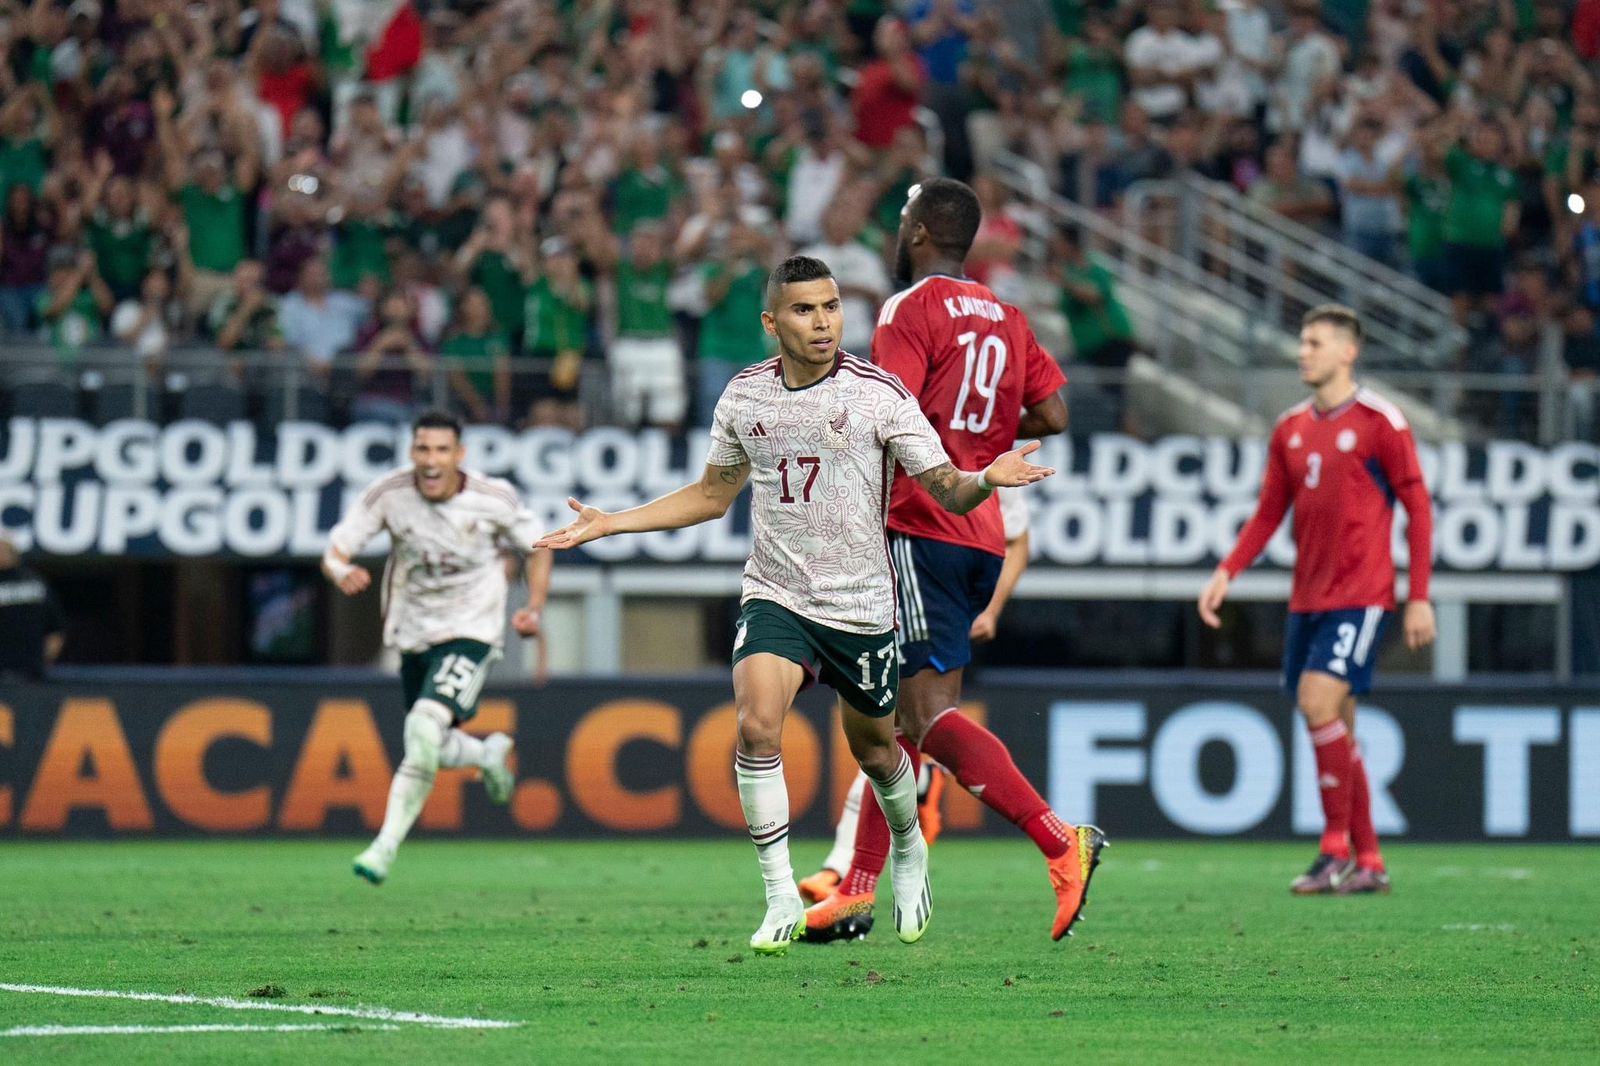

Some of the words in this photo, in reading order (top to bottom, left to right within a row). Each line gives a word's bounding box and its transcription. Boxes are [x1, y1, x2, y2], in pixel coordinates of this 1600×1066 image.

[950, 331, 1007, 434] 19
[776, 456, 821, 504] 17
[1304, 452, 1323, 490] 3
[1332, 622, 1358, 660] 3
[432, 653, 477, 691] 15
[856, 641, 895, 691] 17
[1048, 700, 1409, 835] FOR
[1452, 705, 1600, 838] T
